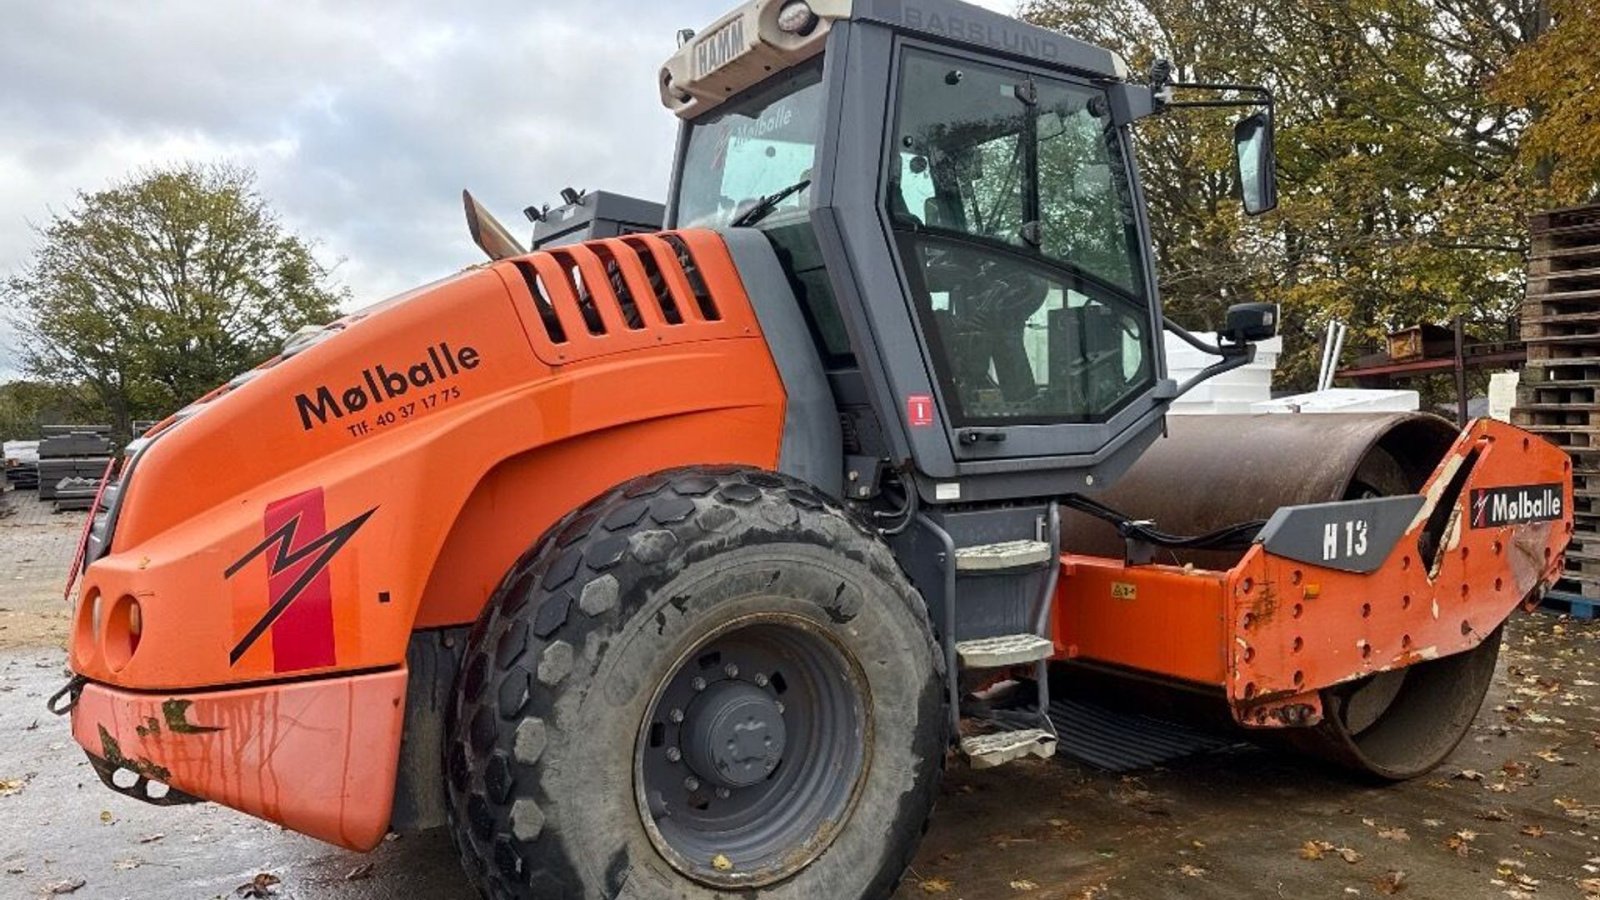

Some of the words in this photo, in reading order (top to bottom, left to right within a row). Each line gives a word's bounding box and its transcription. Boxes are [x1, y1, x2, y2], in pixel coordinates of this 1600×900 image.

[698, 20, 744, 75] HAMM
[294, 342, 480, 430] Mølballe
[376, 411, 396, 427] 40
[398, 402, 416, 419] 37
[421, 394, 437, 410] 17
[441, 385, 461, 403] 75
[1492, 489, 1560, 522] Mølballe
[1323, 523, 1338, 560] H
[1346, 519, 1368, 557] 13
